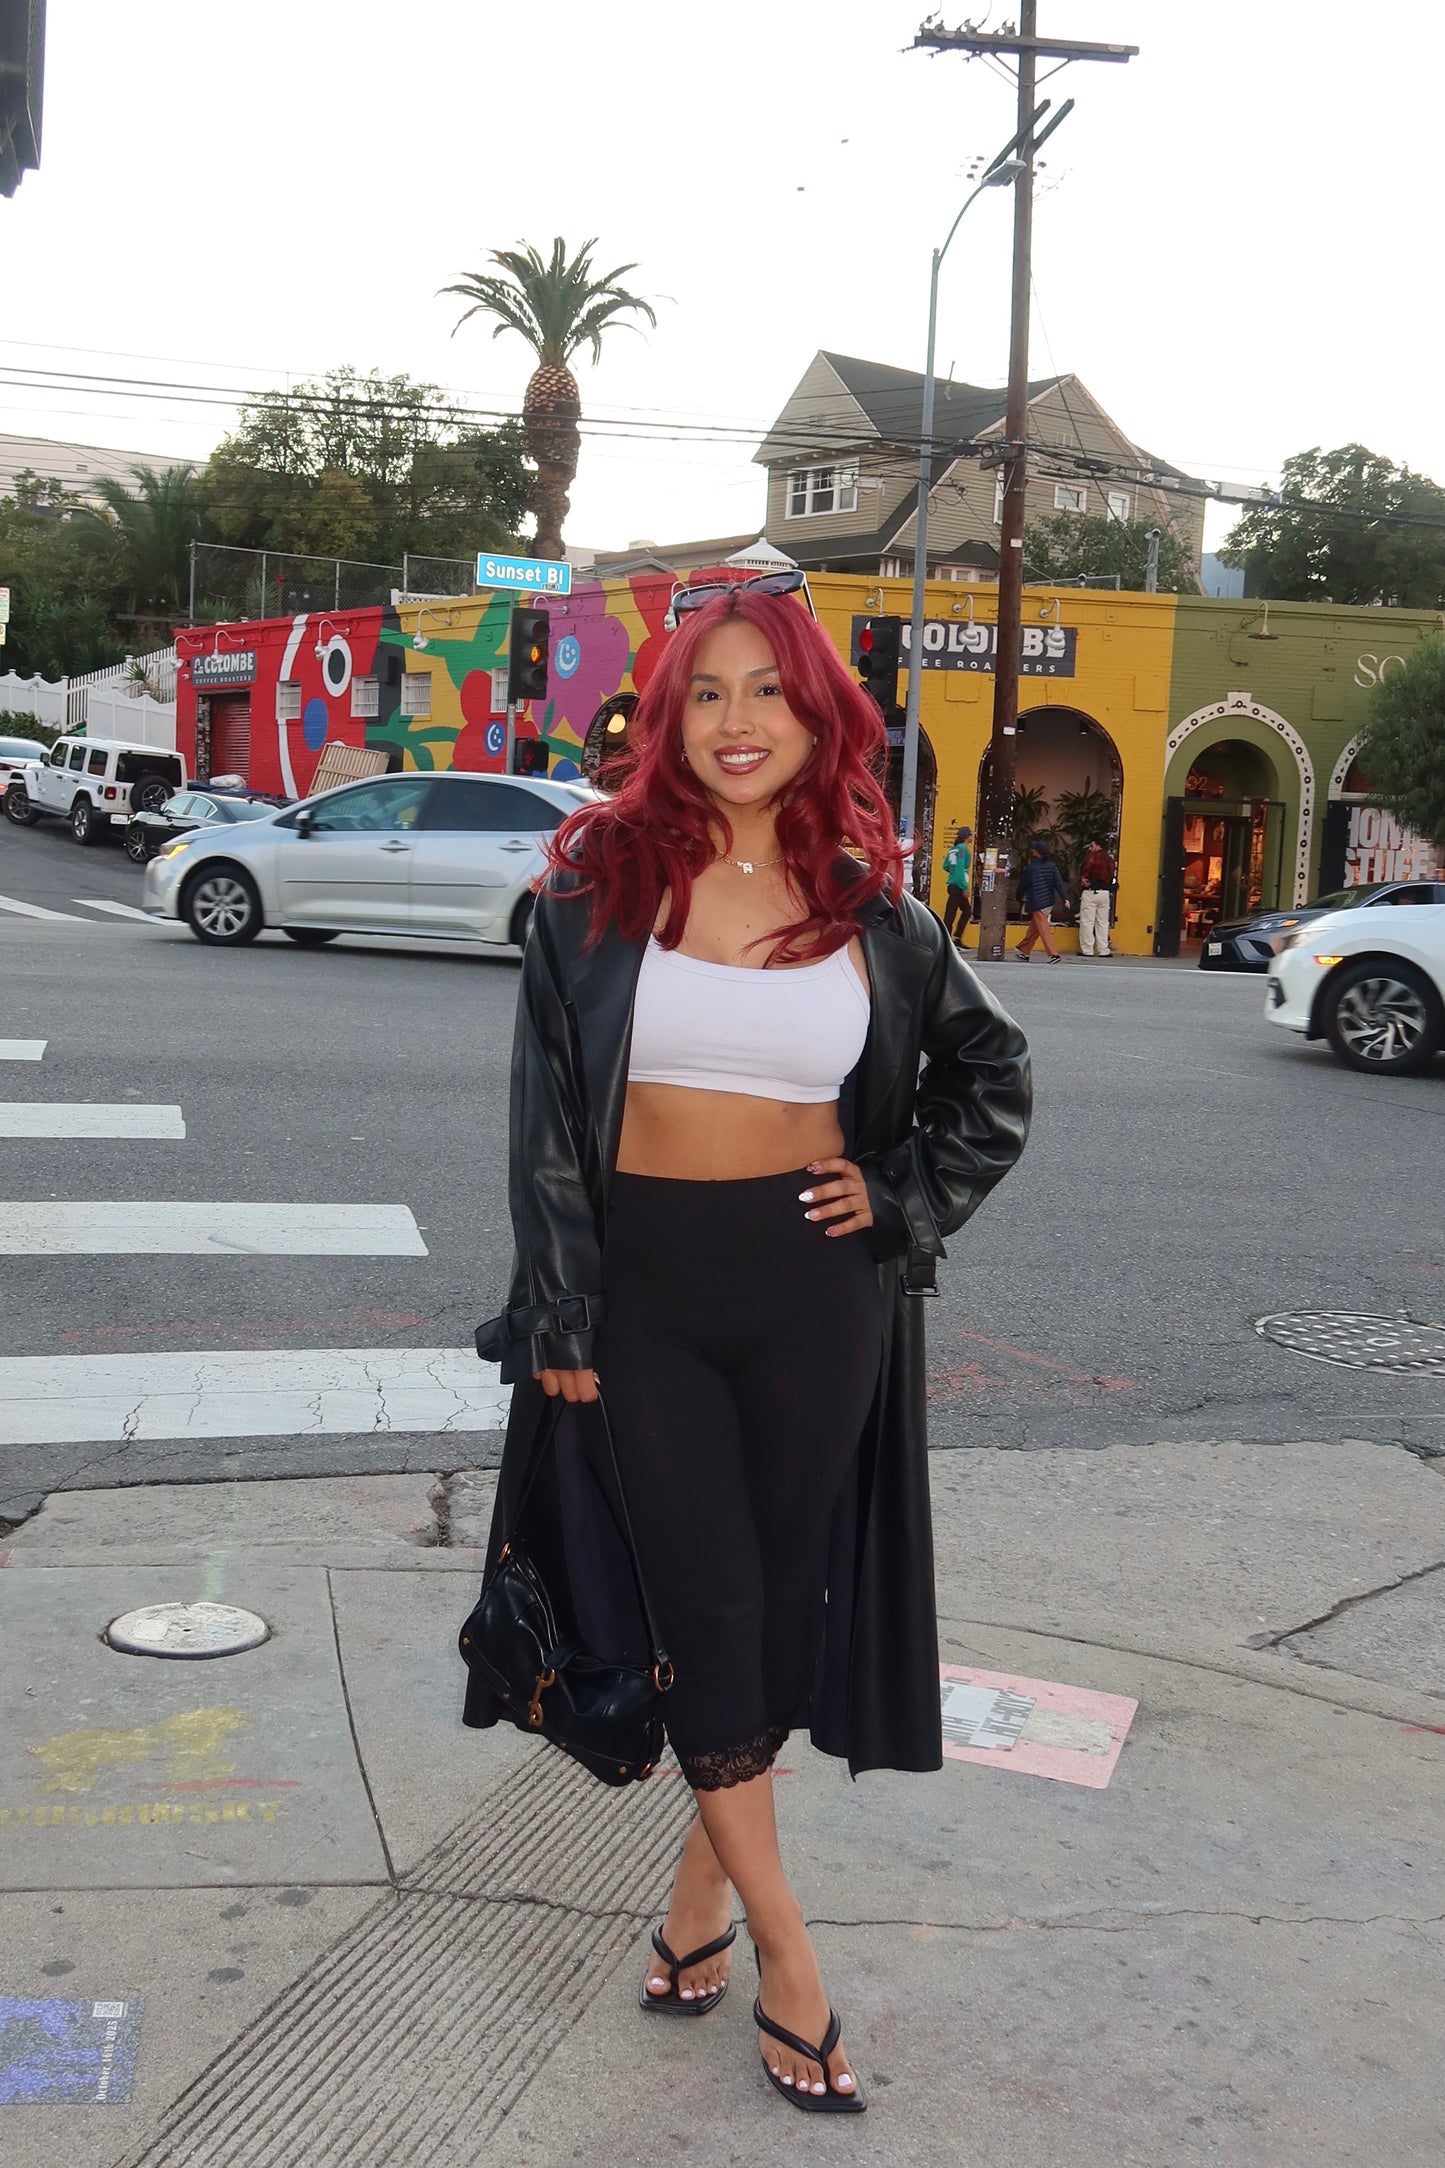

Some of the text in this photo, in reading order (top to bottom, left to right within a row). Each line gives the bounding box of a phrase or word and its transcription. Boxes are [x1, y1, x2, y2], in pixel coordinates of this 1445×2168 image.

[485, 561, 564, 585] Sunset Bl
[96, 2064, 113, 2100] October
